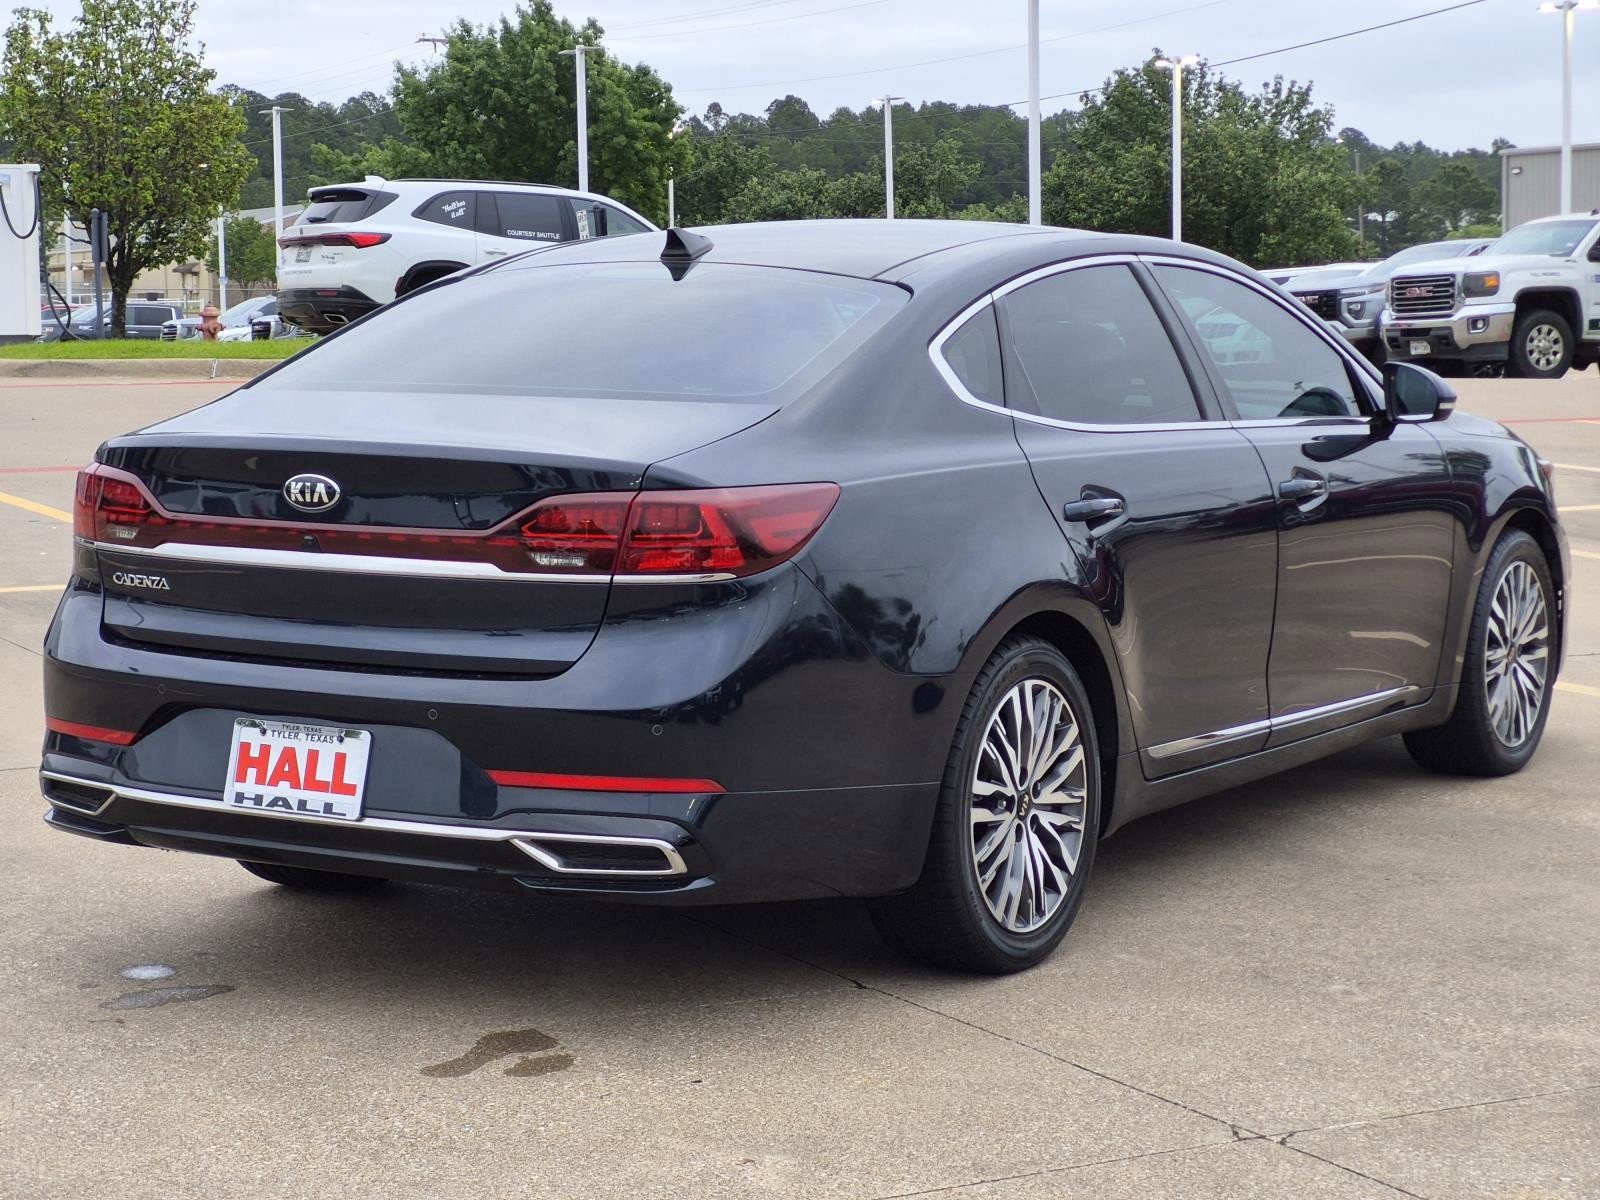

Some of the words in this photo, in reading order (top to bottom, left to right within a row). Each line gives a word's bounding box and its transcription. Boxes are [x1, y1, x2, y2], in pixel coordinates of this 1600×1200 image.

[507, 229, 536, 237] COURTESY
[536, 231, 561, 239] SHUTTLE
[1406, 286, 1433, 297] GMC
[290, 482, 329, 503] KIA
[112, 571, 170, 590] CADENZA
[271, 729, 302, 742] TYLER,
[305, 733, 334, 744] TEXAS
[303, 726, 322, 734] TEXAS
[235, 741, 357, 796] HALL
[234, 792, 347, 816] HALL
[1019, 794, 1030, 816] KIA
